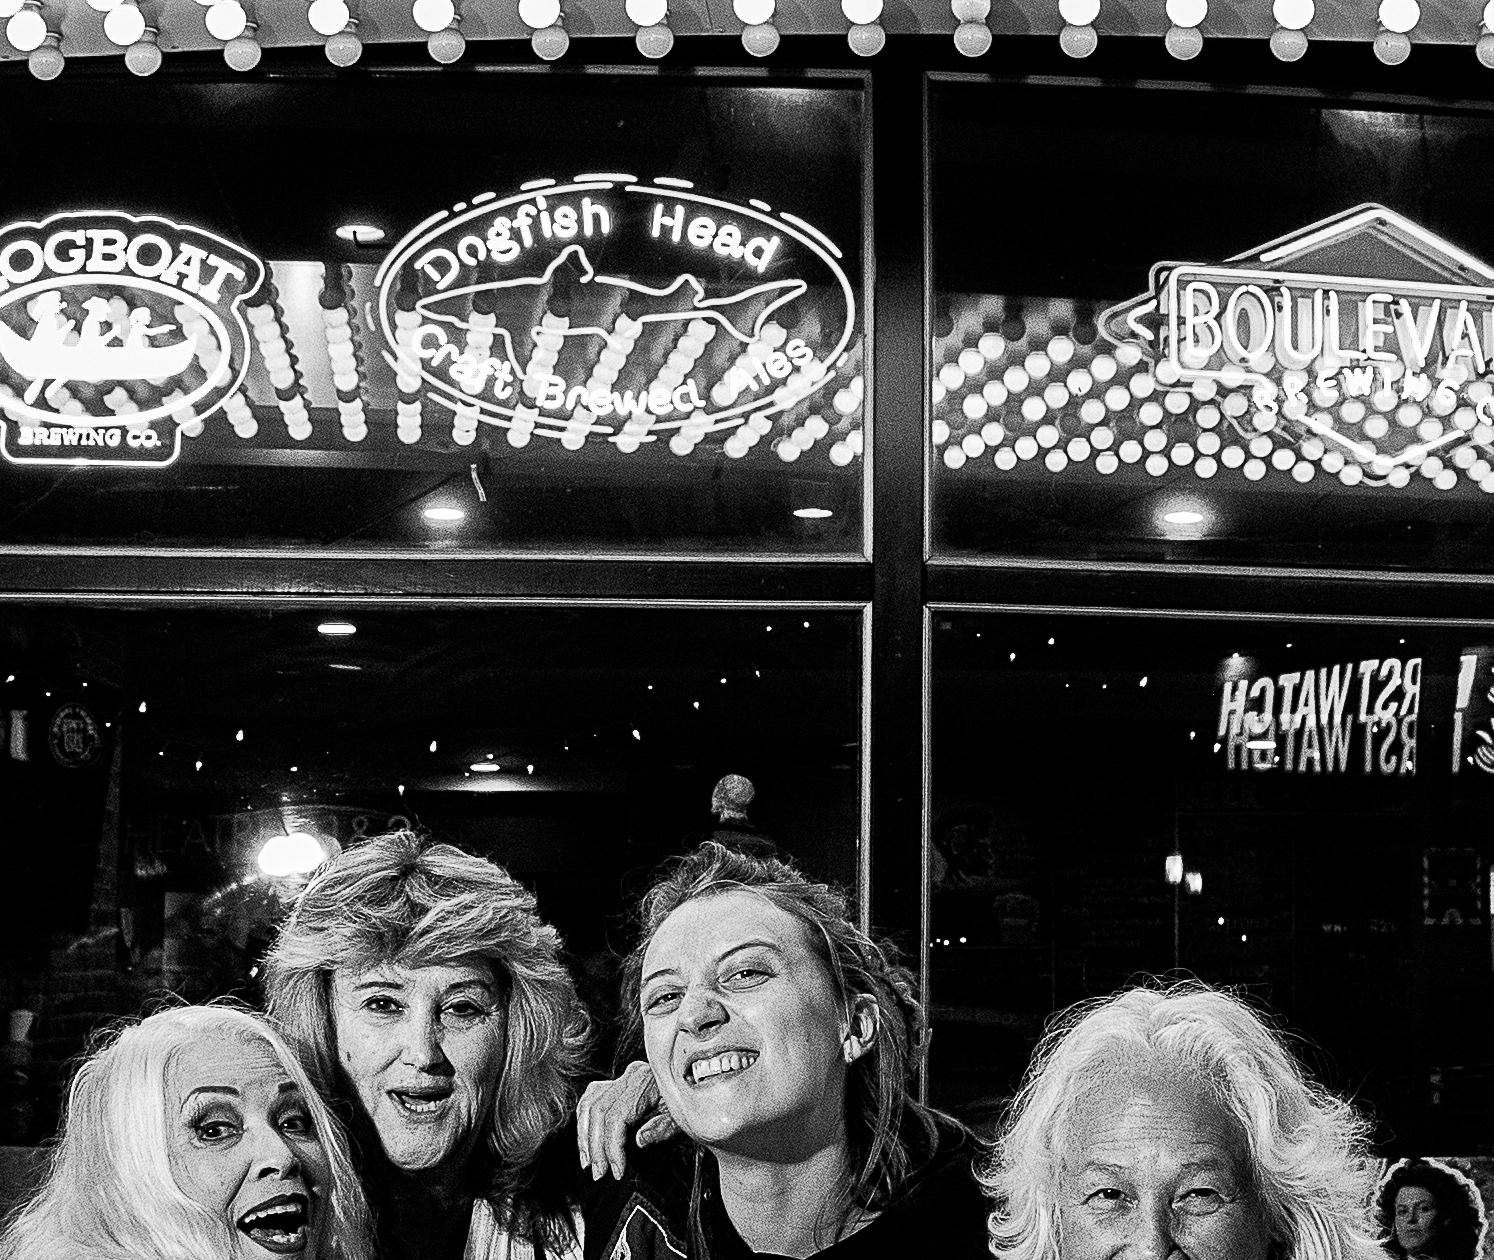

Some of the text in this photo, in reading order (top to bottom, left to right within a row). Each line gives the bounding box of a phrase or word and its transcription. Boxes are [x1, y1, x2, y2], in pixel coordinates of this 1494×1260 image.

[415, 195, 780, 289] Dogfish Head
[412, 323, 814, 415] Craft Brewed Ales
[19, 427, 161, 447] BREWING CO.
